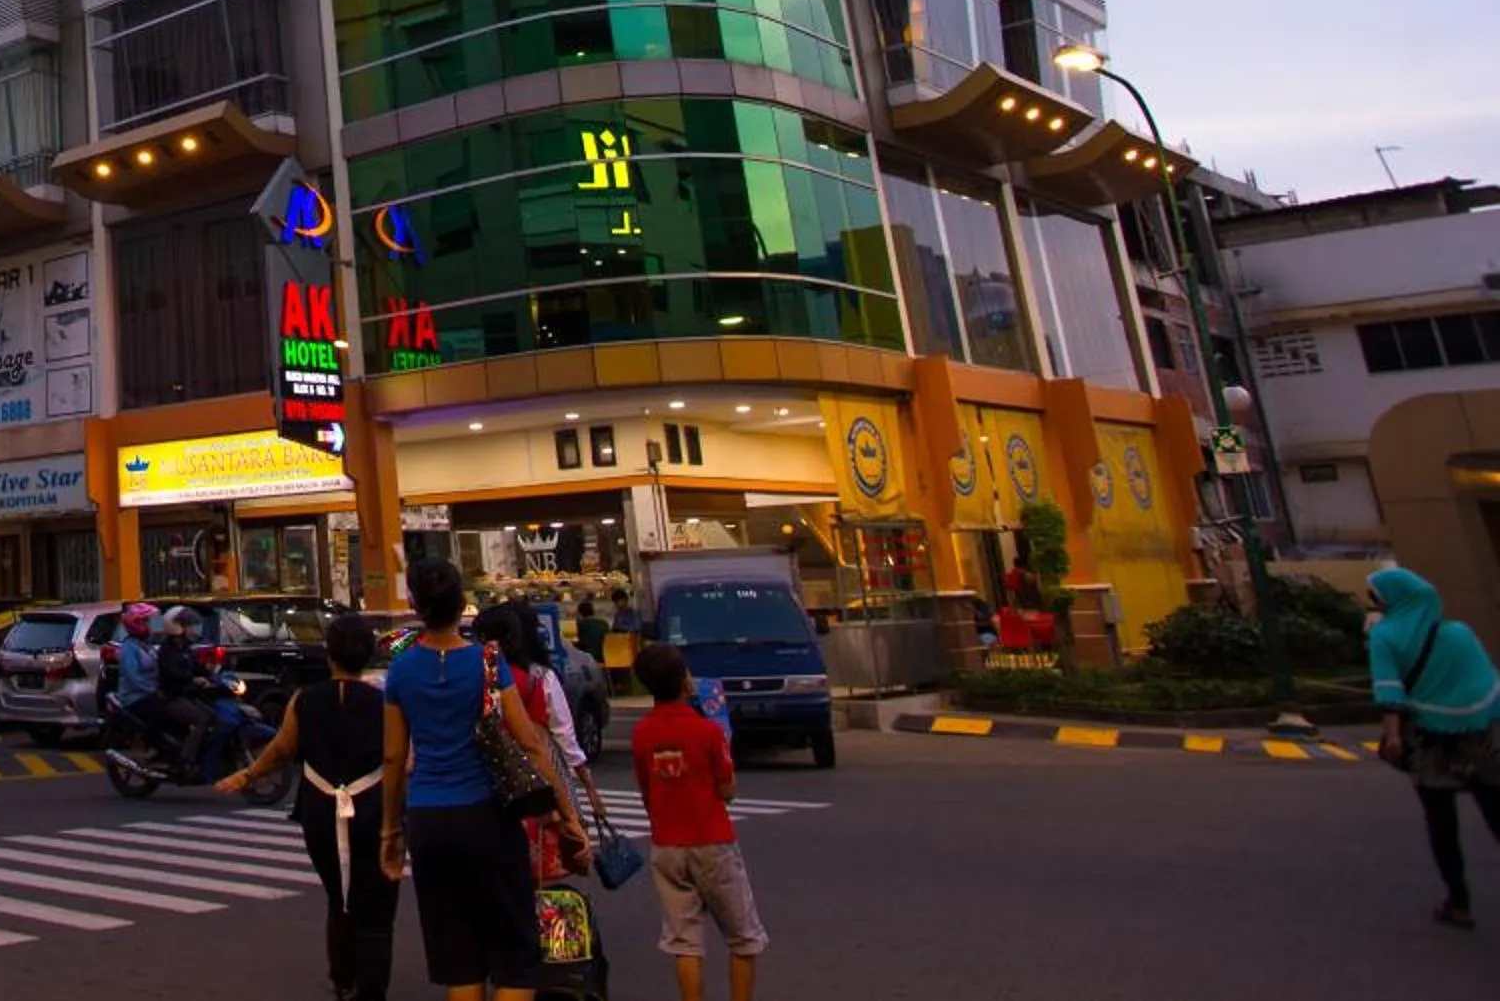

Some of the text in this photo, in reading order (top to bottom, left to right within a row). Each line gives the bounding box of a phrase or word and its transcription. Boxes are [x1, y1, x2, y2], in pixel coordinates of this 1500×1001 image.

[282, 279, 336, 340] AK
[284, 339, 339, 370] HOTEL
[36, 468, 83, 489] Star
[525, 551, 558, 573] NB
